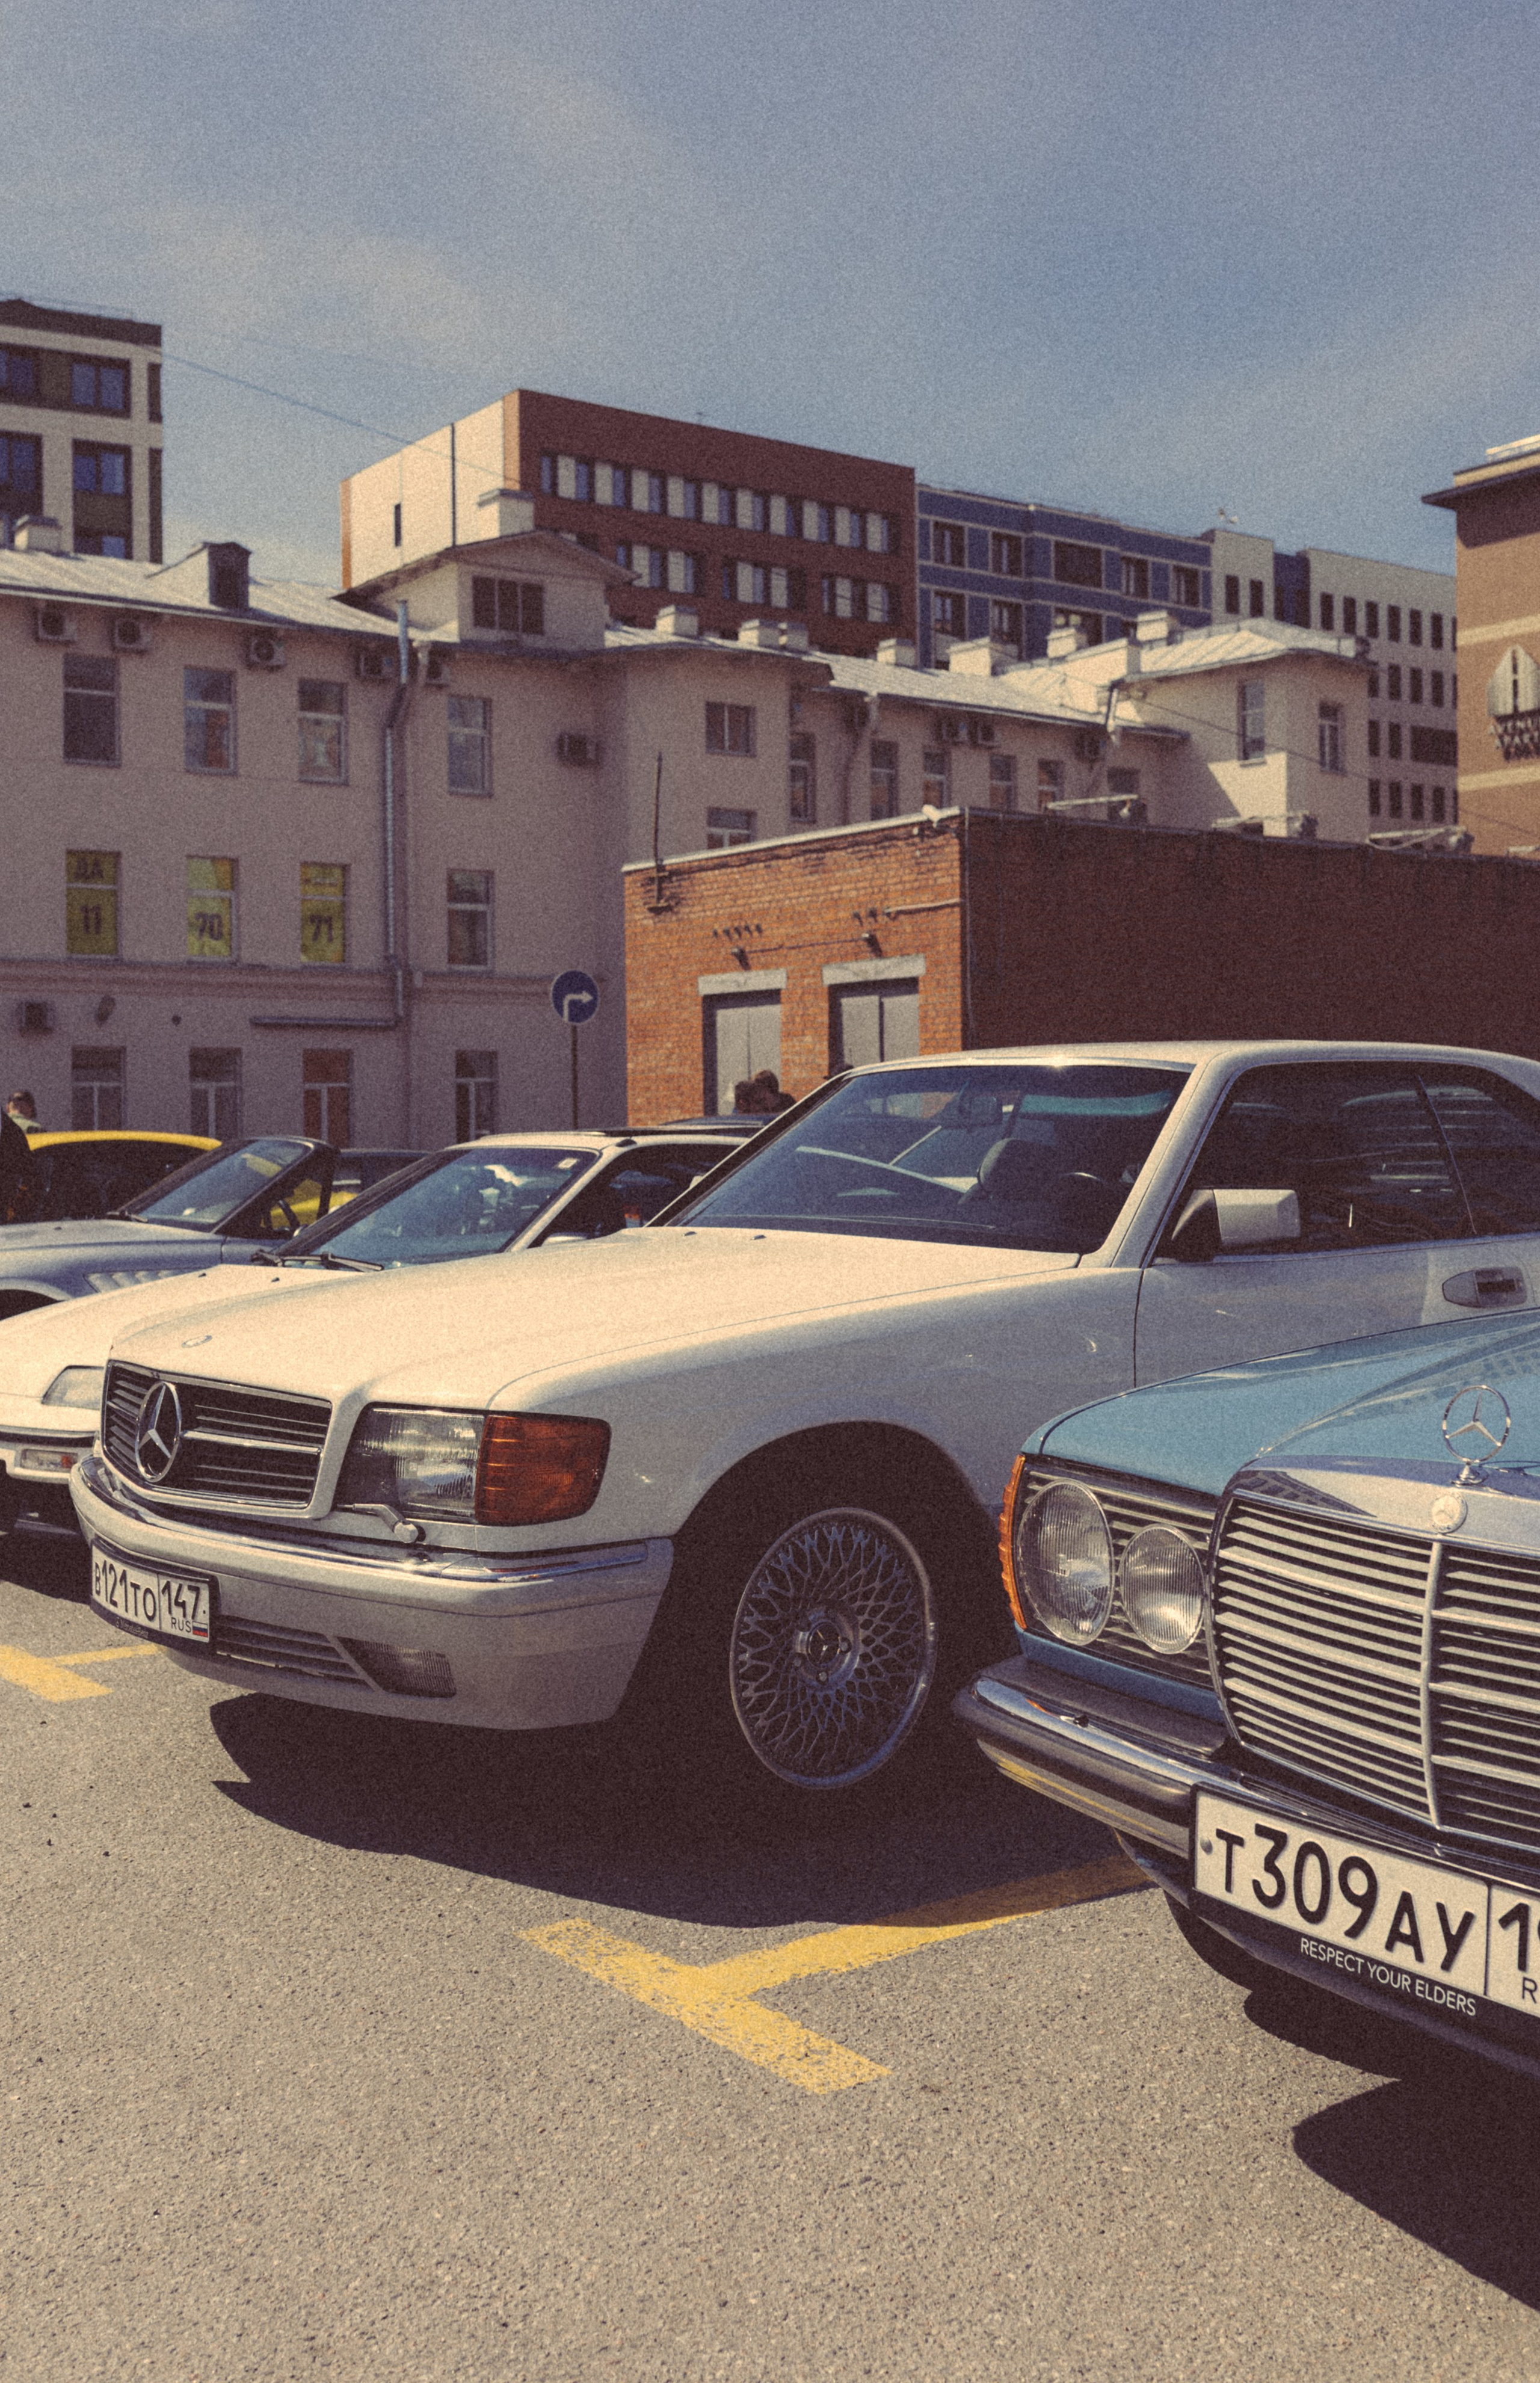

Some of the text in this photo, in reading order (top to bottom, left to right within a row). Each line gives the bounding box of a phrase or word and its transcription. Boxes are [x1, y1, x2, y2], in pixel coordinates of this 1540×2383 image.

[1488, 716, 1540, 735] AVENU
[161, 1580, 200, 1620] 147
[171, 1617, 191, 1633] RUS
[1498, 1902, 1540, 1972] 1
[1301, 1938, 1476, 2017] RESPECT YOUR ELDERS
